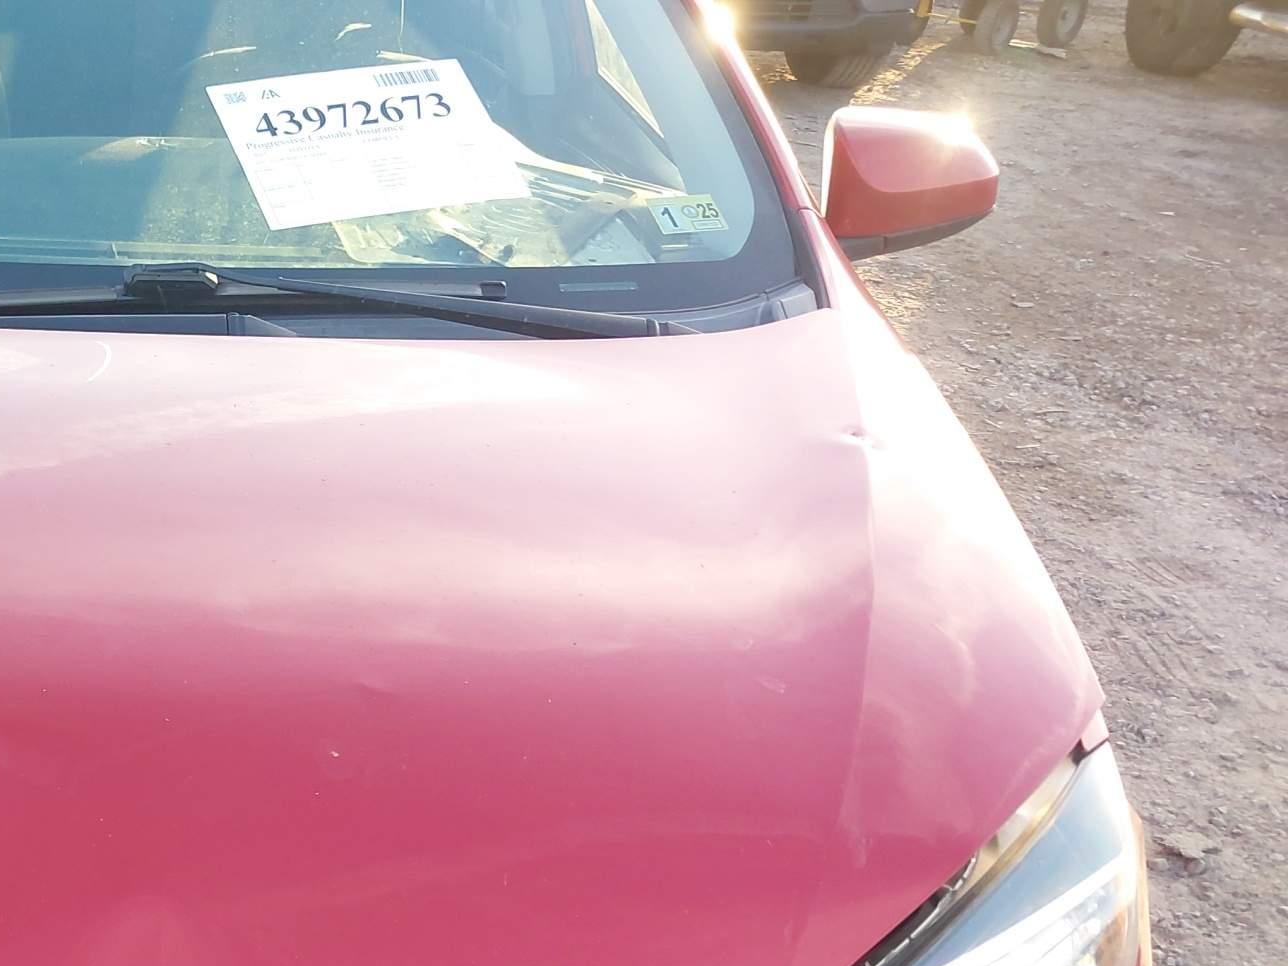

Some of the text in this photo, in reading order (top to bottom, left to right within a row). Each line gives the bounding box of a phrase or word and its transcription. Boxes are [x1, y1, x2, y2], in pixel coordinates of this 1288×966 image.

[255, 92, 452, 137] 43972673
[245, 136, 306, 152] Progressive
[661, 203, 719, 228] 1 25
